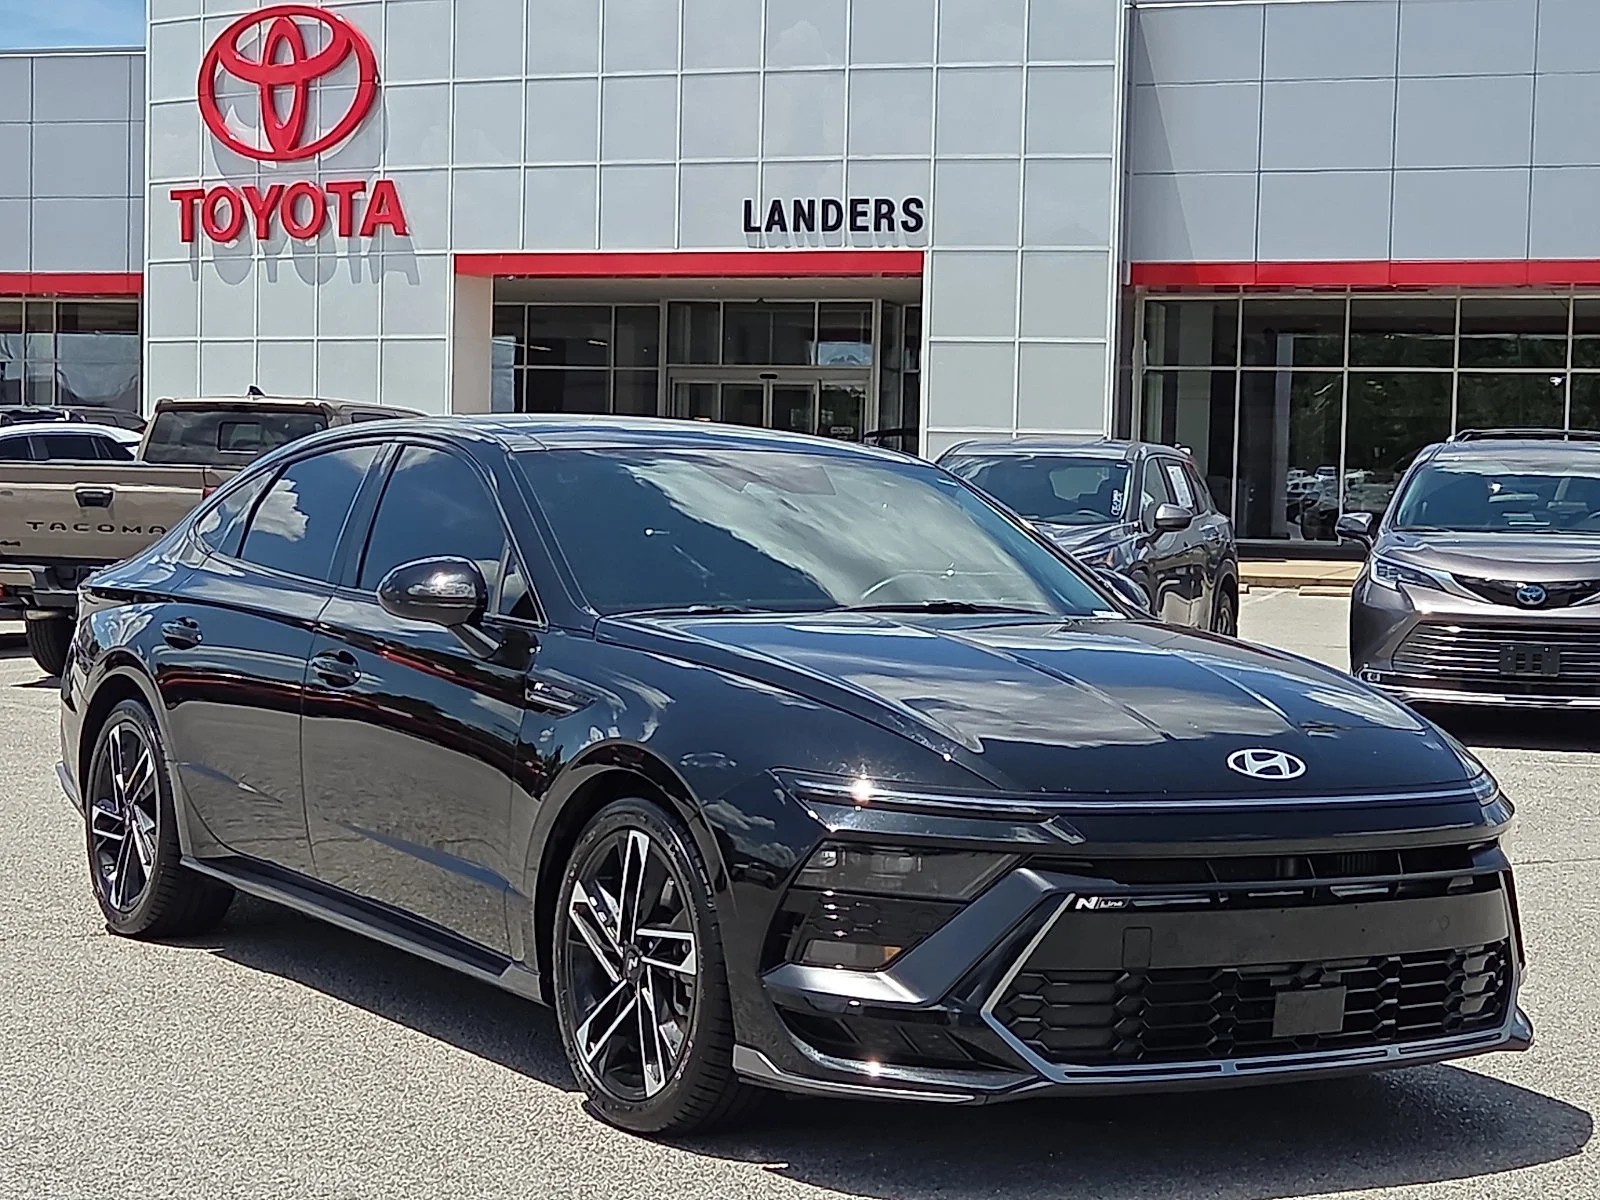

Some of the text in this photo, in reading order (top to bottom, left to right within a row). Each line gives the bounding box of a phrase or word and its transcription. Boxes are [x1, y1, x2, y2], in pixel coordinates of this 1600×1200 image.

[170, 180, 410, 243] TOYOTA
[743, 197, 925, 234] LANDERS
[26, 520, 168, 536] TACOMA
[1075, 896, 1098, 910] N
